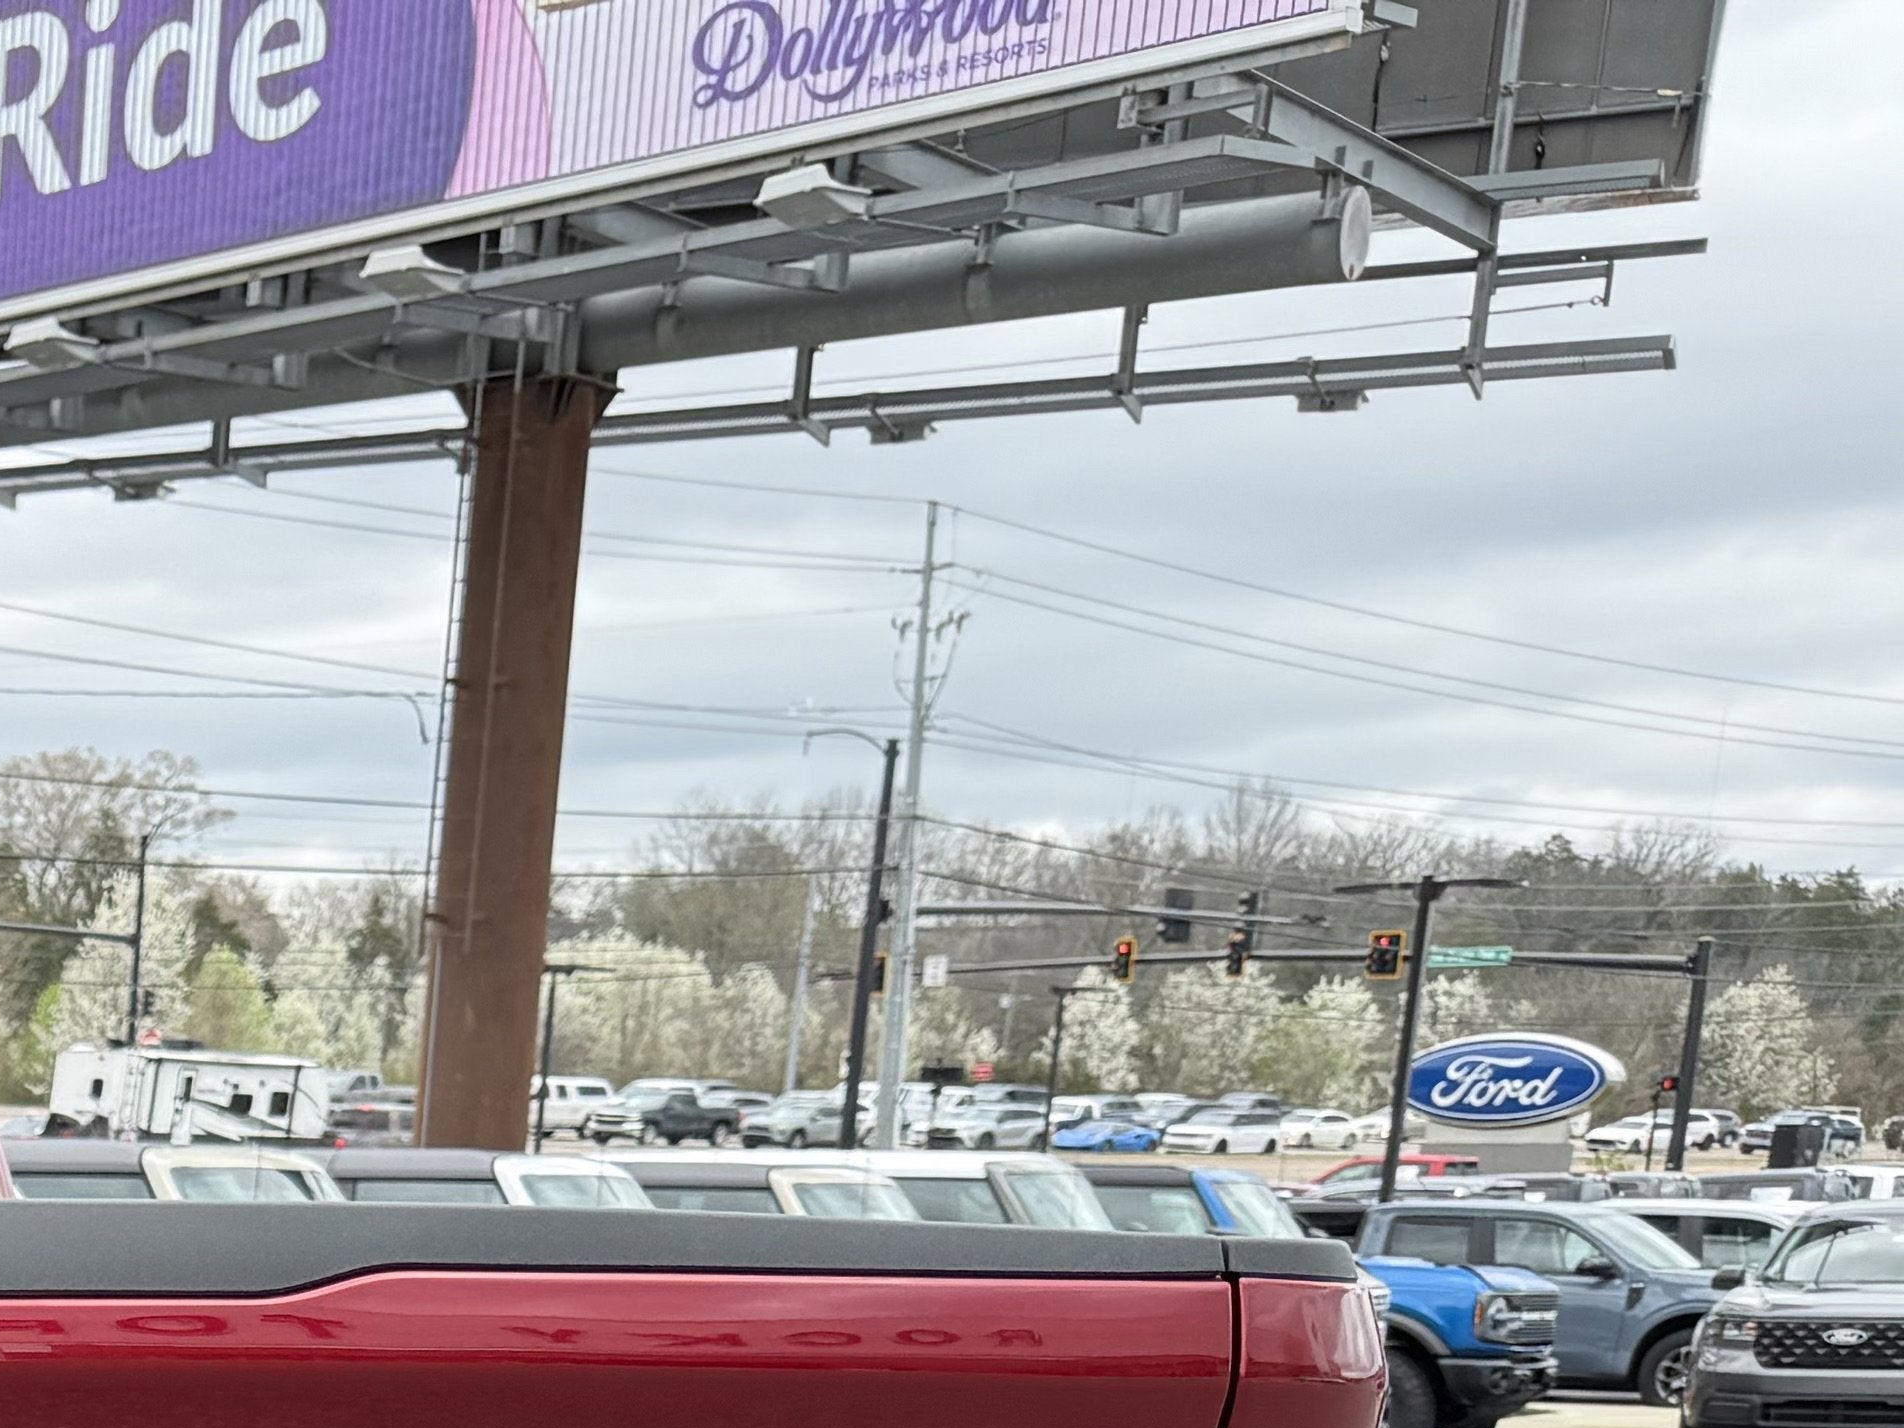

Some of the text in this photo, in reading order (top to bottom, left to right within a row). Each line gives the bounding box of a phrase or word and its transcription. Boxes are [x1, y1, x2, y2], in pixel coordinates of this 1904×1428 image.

[869, 64, 931, 90] PARKS
[957, 37, 1048, 71] RESORTS
[1430, 1055, 1563, 1107] Ford
